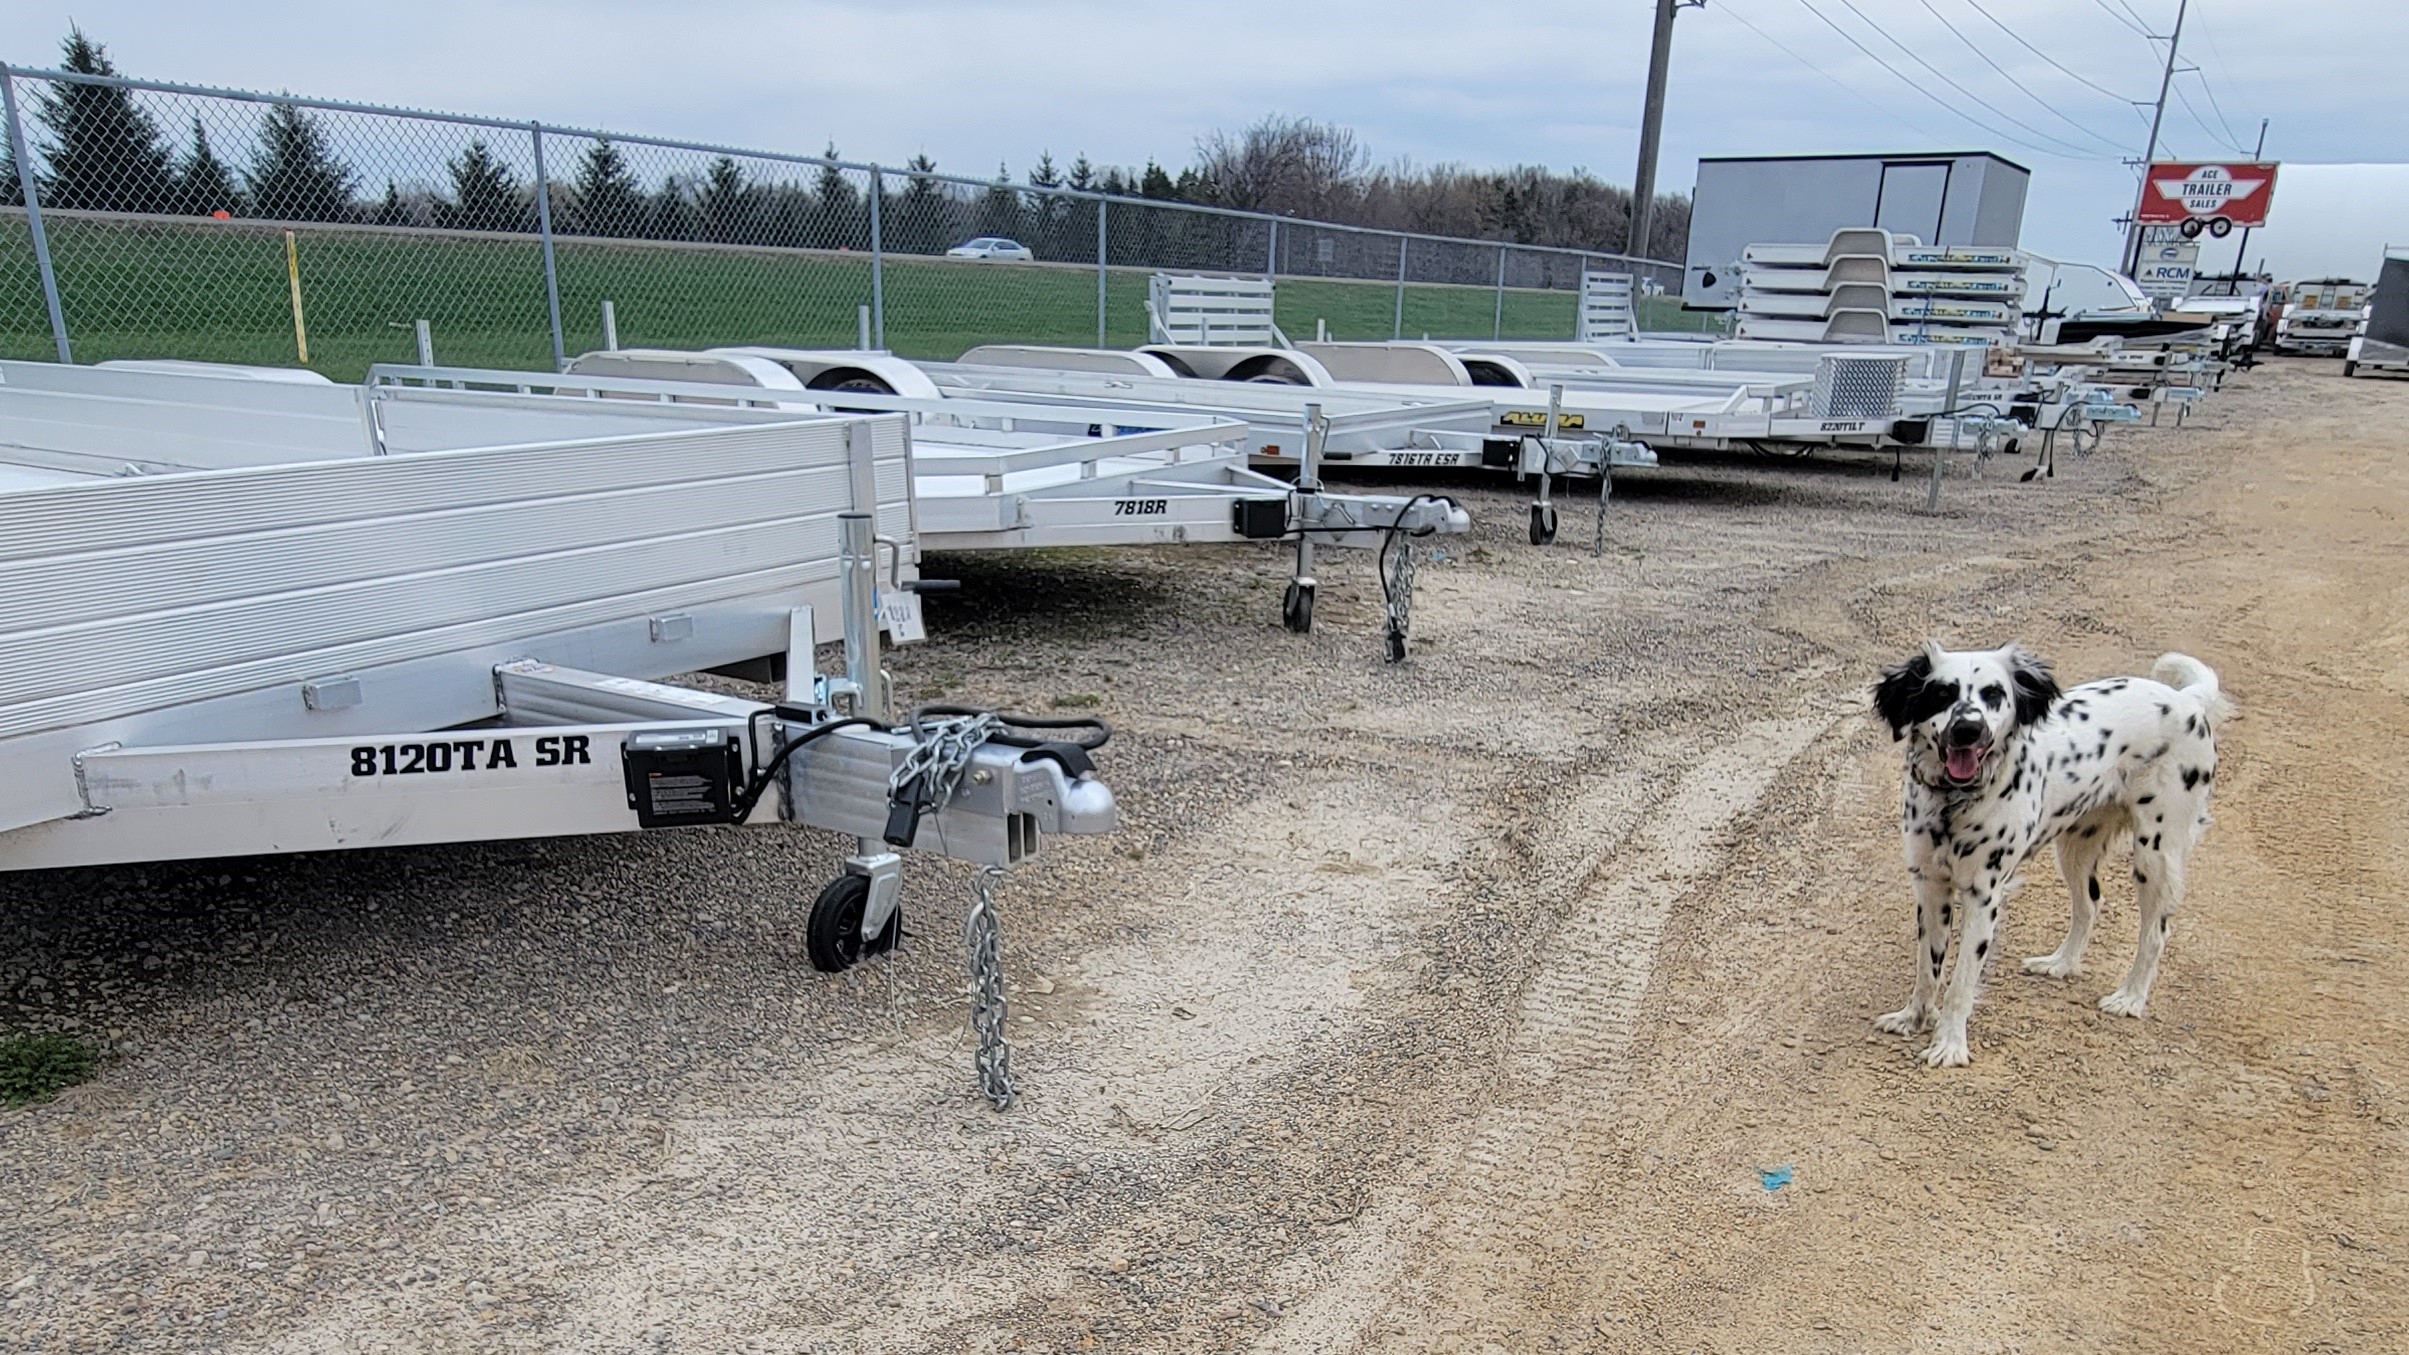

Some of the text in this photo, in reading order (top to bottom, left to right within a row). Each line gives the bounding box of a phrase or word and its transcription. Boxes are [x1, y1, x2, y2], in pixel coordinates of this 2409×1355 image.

[2201, 170, 2218, 179] ACE
[2182, 183, 2232, 196] TRAILER
[2189, 199, 2217, 208] SALES
[2156, 267, 2190, 278] RCM
[1114, 499, 1168, 516] 7818R
[351, 735, 591, 776] 8120TA SR
